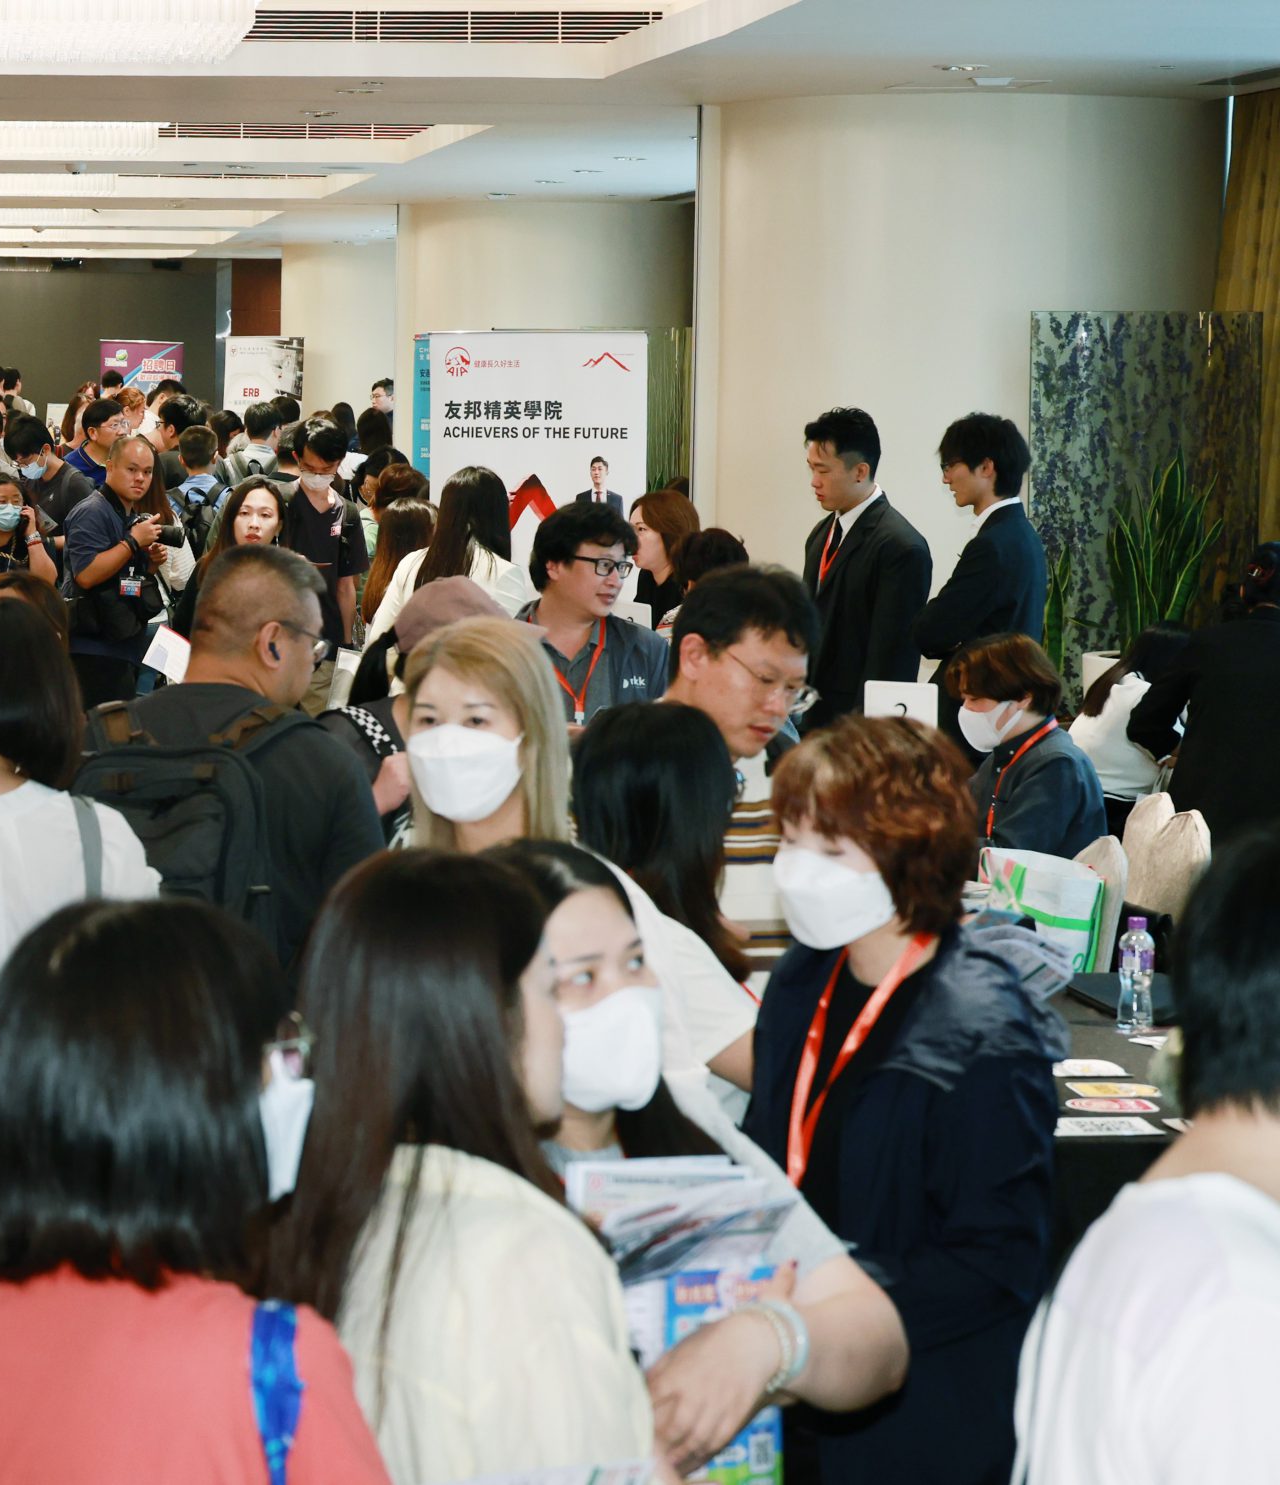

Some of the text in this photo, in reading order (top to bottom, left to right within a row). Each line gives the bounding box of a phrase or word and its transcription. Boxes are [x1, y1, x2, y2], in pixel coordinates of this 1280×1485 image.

[142, 358, 176, 372] 招聘日
[474, 359, 520, 368] 健康長久好生活
[447, 366, 468, 376] AIA
[243, 388, 260, 397] ERB
[444, 400, 562, 420] 友邦精英學院
[443, 426, 628, 440] ACHIEVERS OF THE FUTURE
